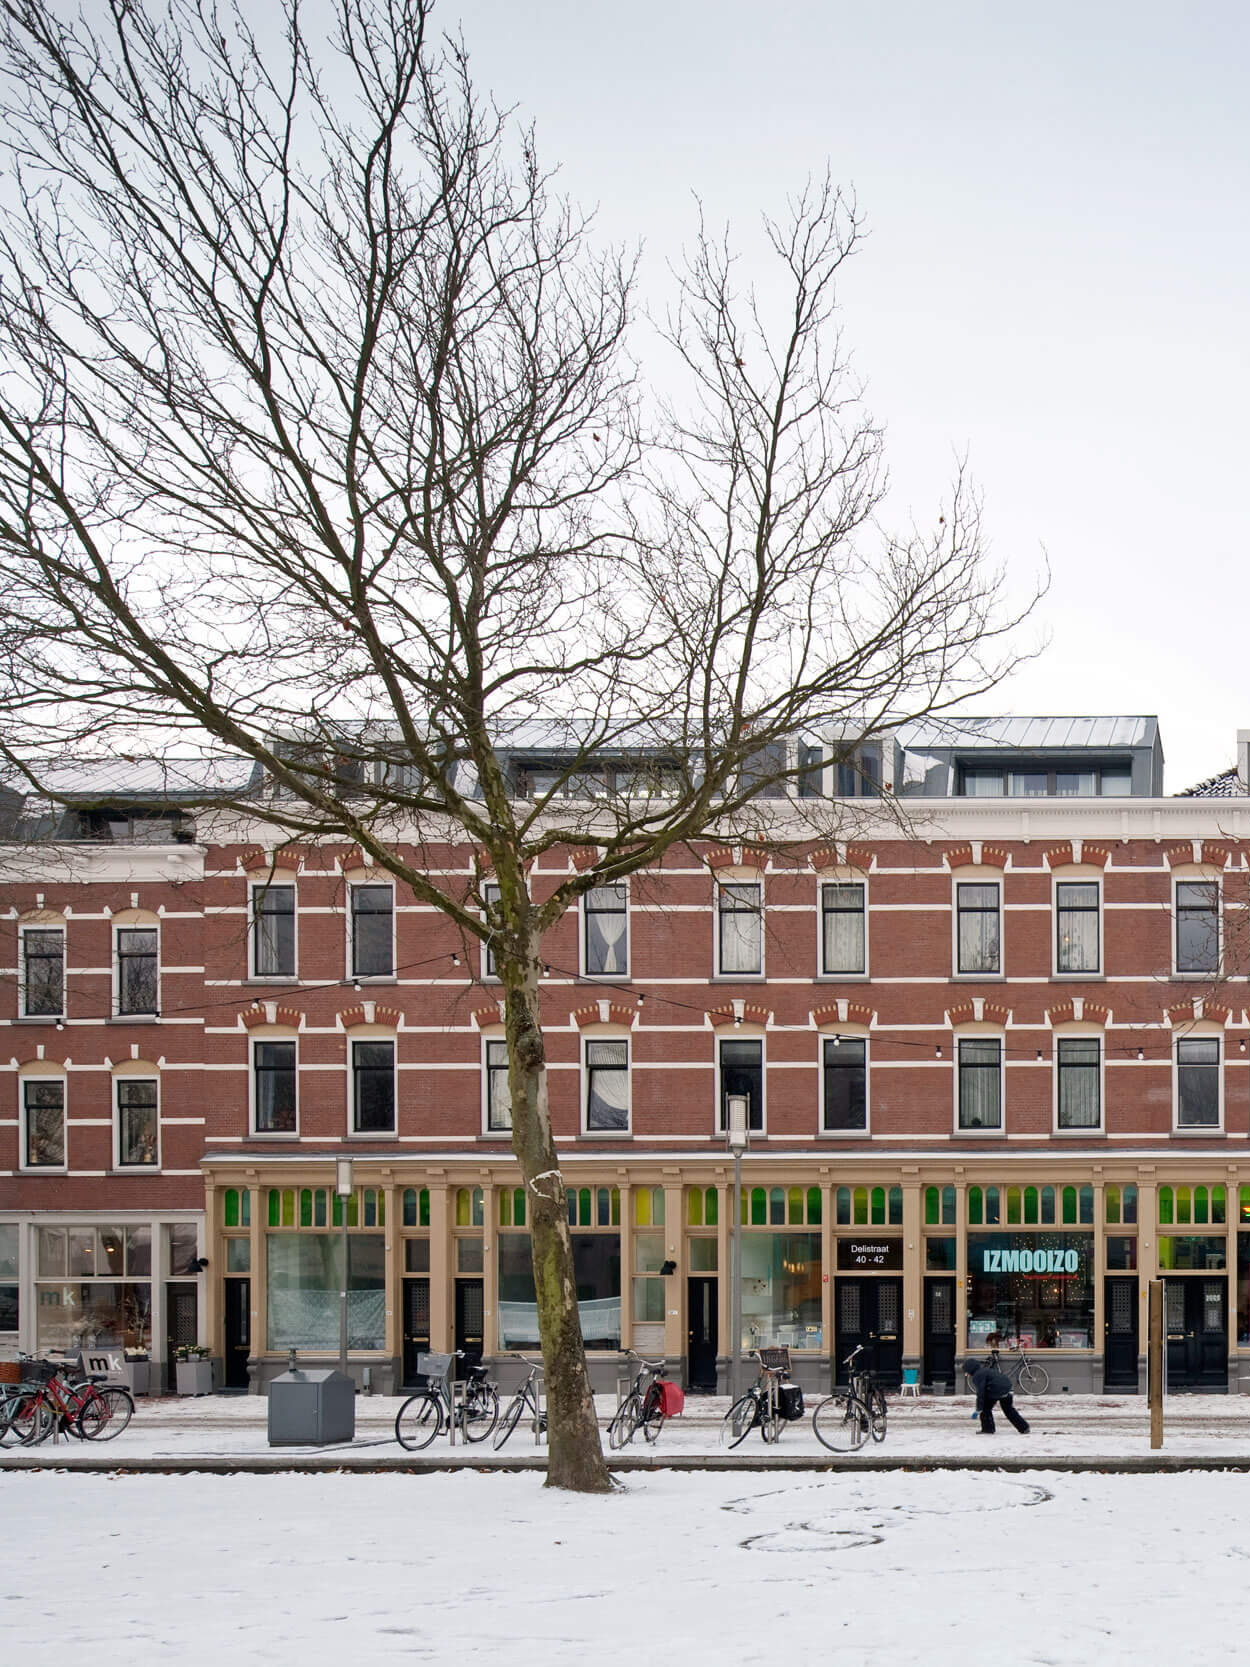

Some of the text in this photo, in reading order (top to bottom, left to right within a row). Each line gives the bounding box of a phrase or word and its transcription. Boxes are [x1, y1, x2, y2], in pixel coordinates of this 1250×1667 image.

[850, 1244, 890, 1253] Delistraat
[855, 1255, 867, 1264] 40
[873, 1255, 885, 1264] 42
[983, 1249, 1079, 1273] IZMOOIZO
[40, 1286, 76, 1306] mk
[88, 1354, 122, 1372] mk
